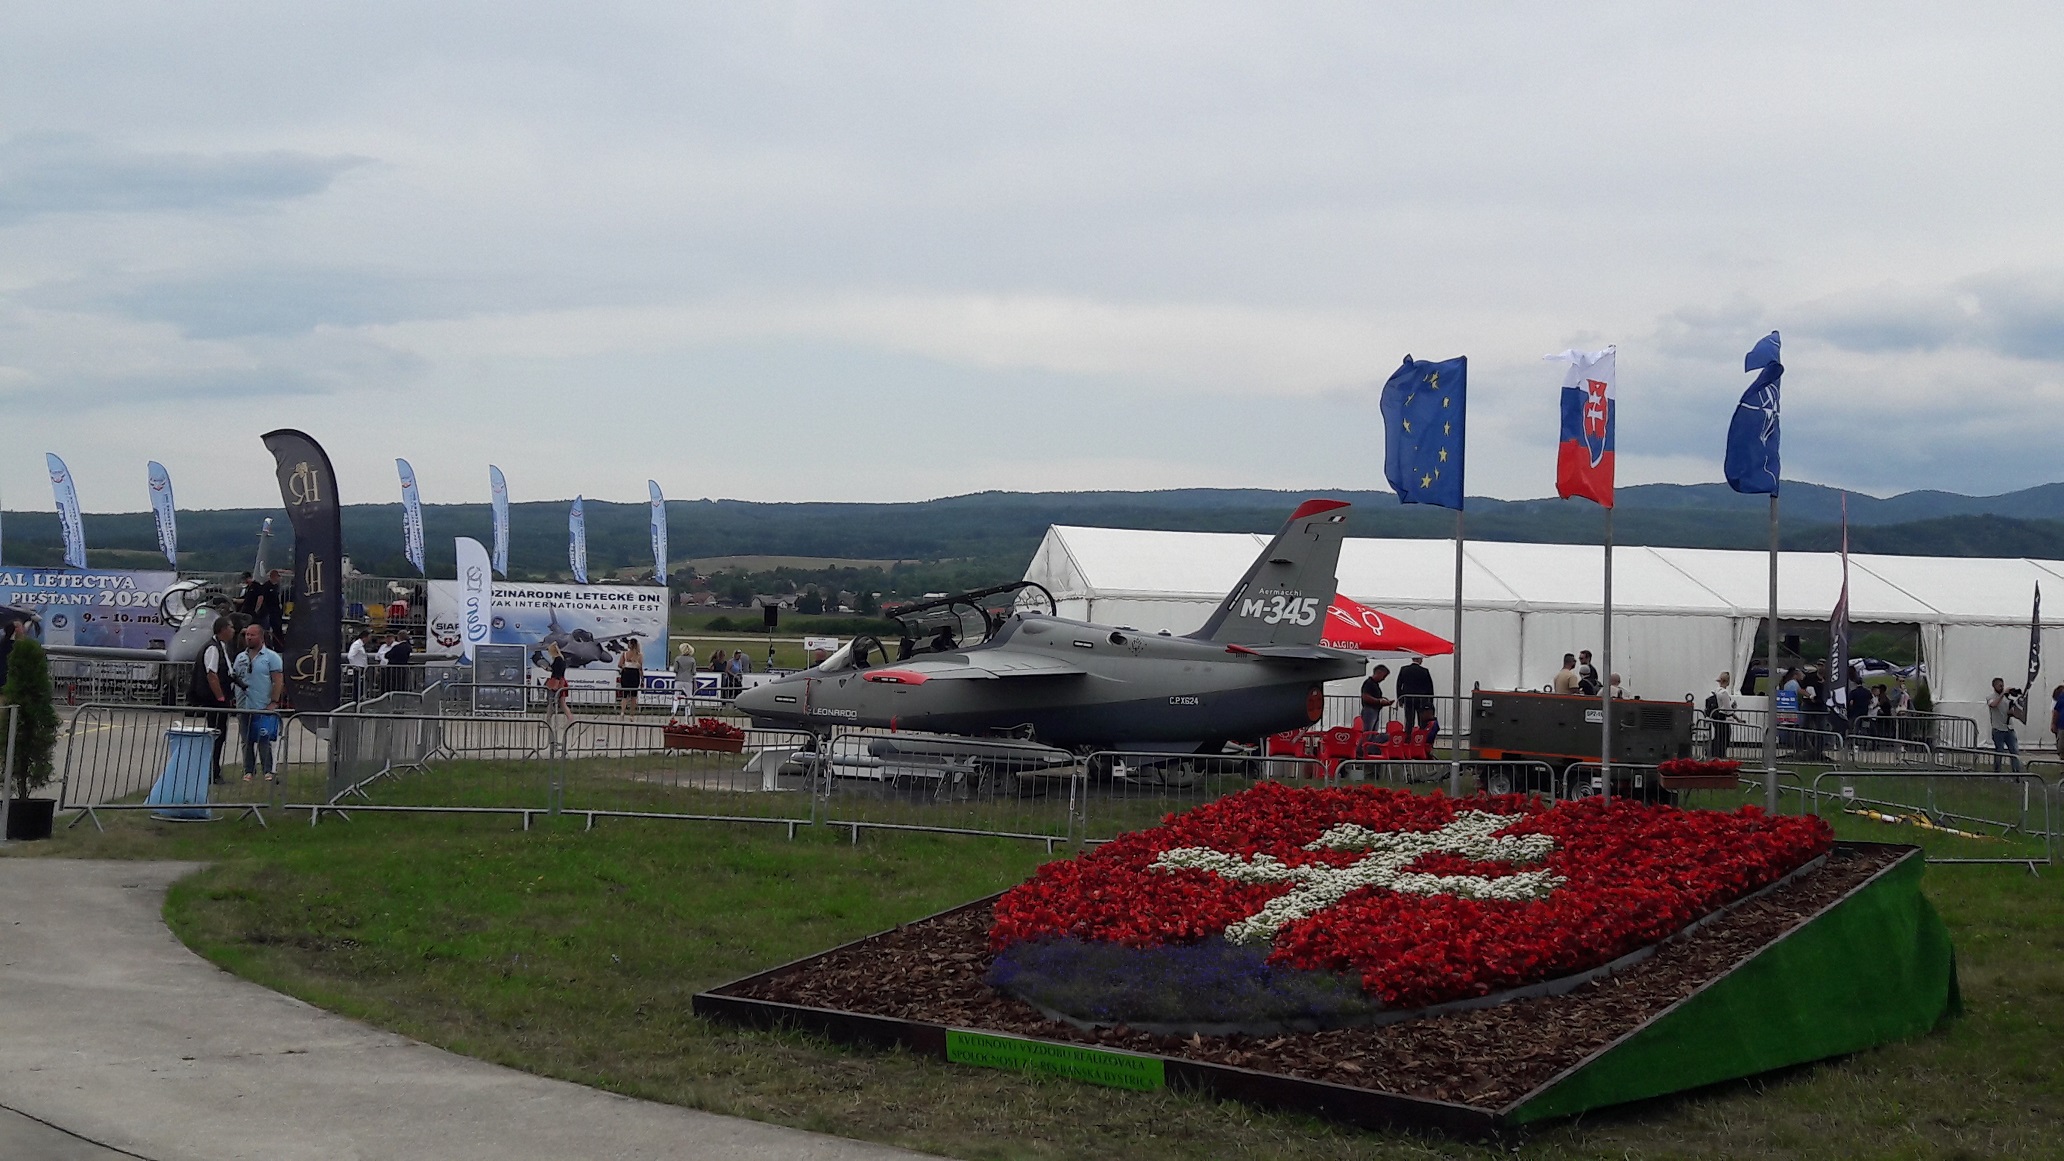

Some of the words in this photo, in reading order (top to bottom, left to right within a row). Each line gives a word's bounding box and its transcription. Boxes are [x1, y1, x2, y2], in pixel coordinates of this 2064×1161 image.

[32, 573, 137, 590] LETECTVA
[576, 591, 634, 602] LETECKÉ
[641, 593, 661, 603] DNI
[1259, 588, 1302, 597] Aermacchi
[99, 590, 162, 608] 2020
[515, 601, 607, 610] INTERNATIONAL
[610, 603, 629, 611] AIR
[632, 604, 660, 612] FEST
[1240, 596, 1319, 626] M-345
[82, 613, 96, 623] 9.
[114, 613, 133, 623] 10.
[1332, 641, 1359, 650] ALGIDA
[812, 707, 858, 718] LEONARDO
